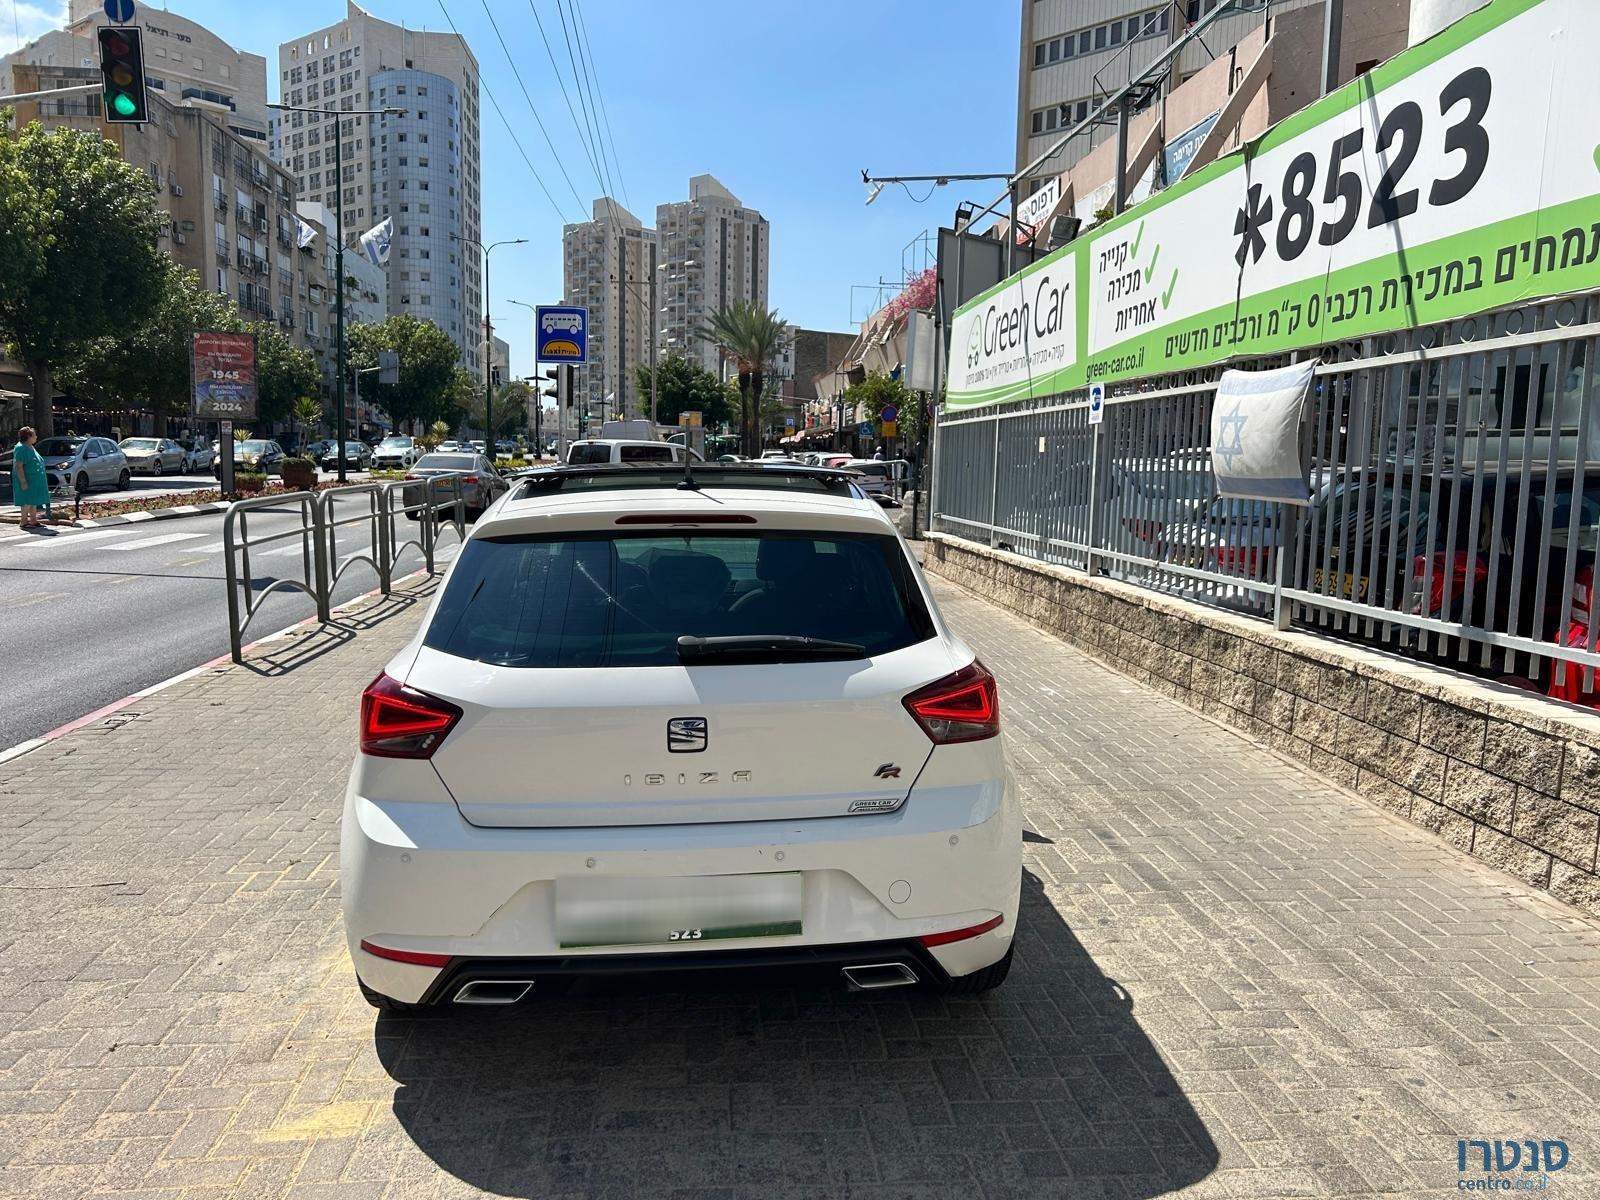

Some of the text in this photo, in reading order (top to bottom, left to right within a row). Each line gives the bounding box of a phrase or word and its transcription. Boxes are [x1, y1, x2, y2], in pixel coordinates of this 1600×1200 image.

[1030, 186, 1054, 216] דפוס
[1100, 241, 1128, 273] קנייה
[1108, 269, 1140, 302] מכירה
[1378, 255, 1482, 312] במכירת
[984, 276, 1070, 358] Green Car
[1115, 297, 1157, 332] אחריות
[1307, 294, 1320, 328] 0
[1326, 283, 1374, 324] רכבי
[1164, 326, 1209, 358] חדשים
[1212, 316, 1262, 349] ורכבים
[212, 370, 240, 379] 1945
[1086, 346, 1144, 382] green-car.co.il
[212, 402, 242, 411] 2024
[624, 770, 752, 786] IBIZA
